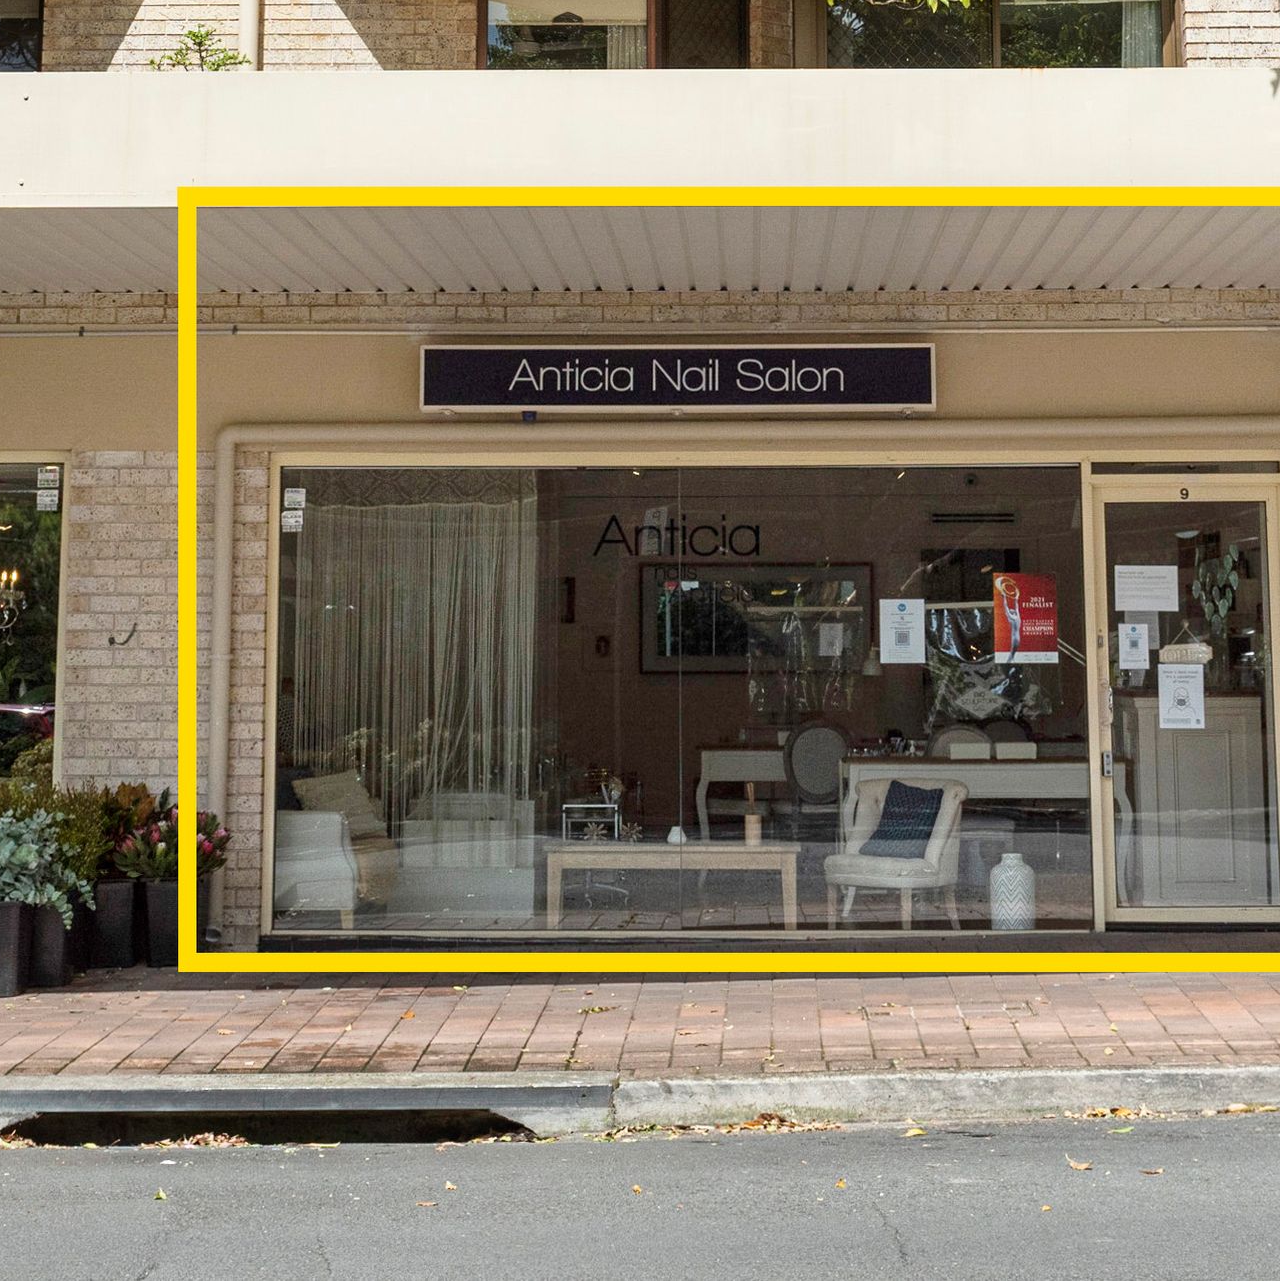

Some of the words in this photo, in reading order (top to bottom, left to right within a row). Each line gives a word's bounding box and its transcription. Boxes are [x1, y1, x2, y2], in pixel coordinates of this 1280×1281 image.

[508, 358, 634, 392] Anticia
[652, 358, 720, 392] Nail
[736, 358, 845, 392] Salon
[1180, 488, 1189, 500] 9
[593, 514, 760, 557] Anticia
